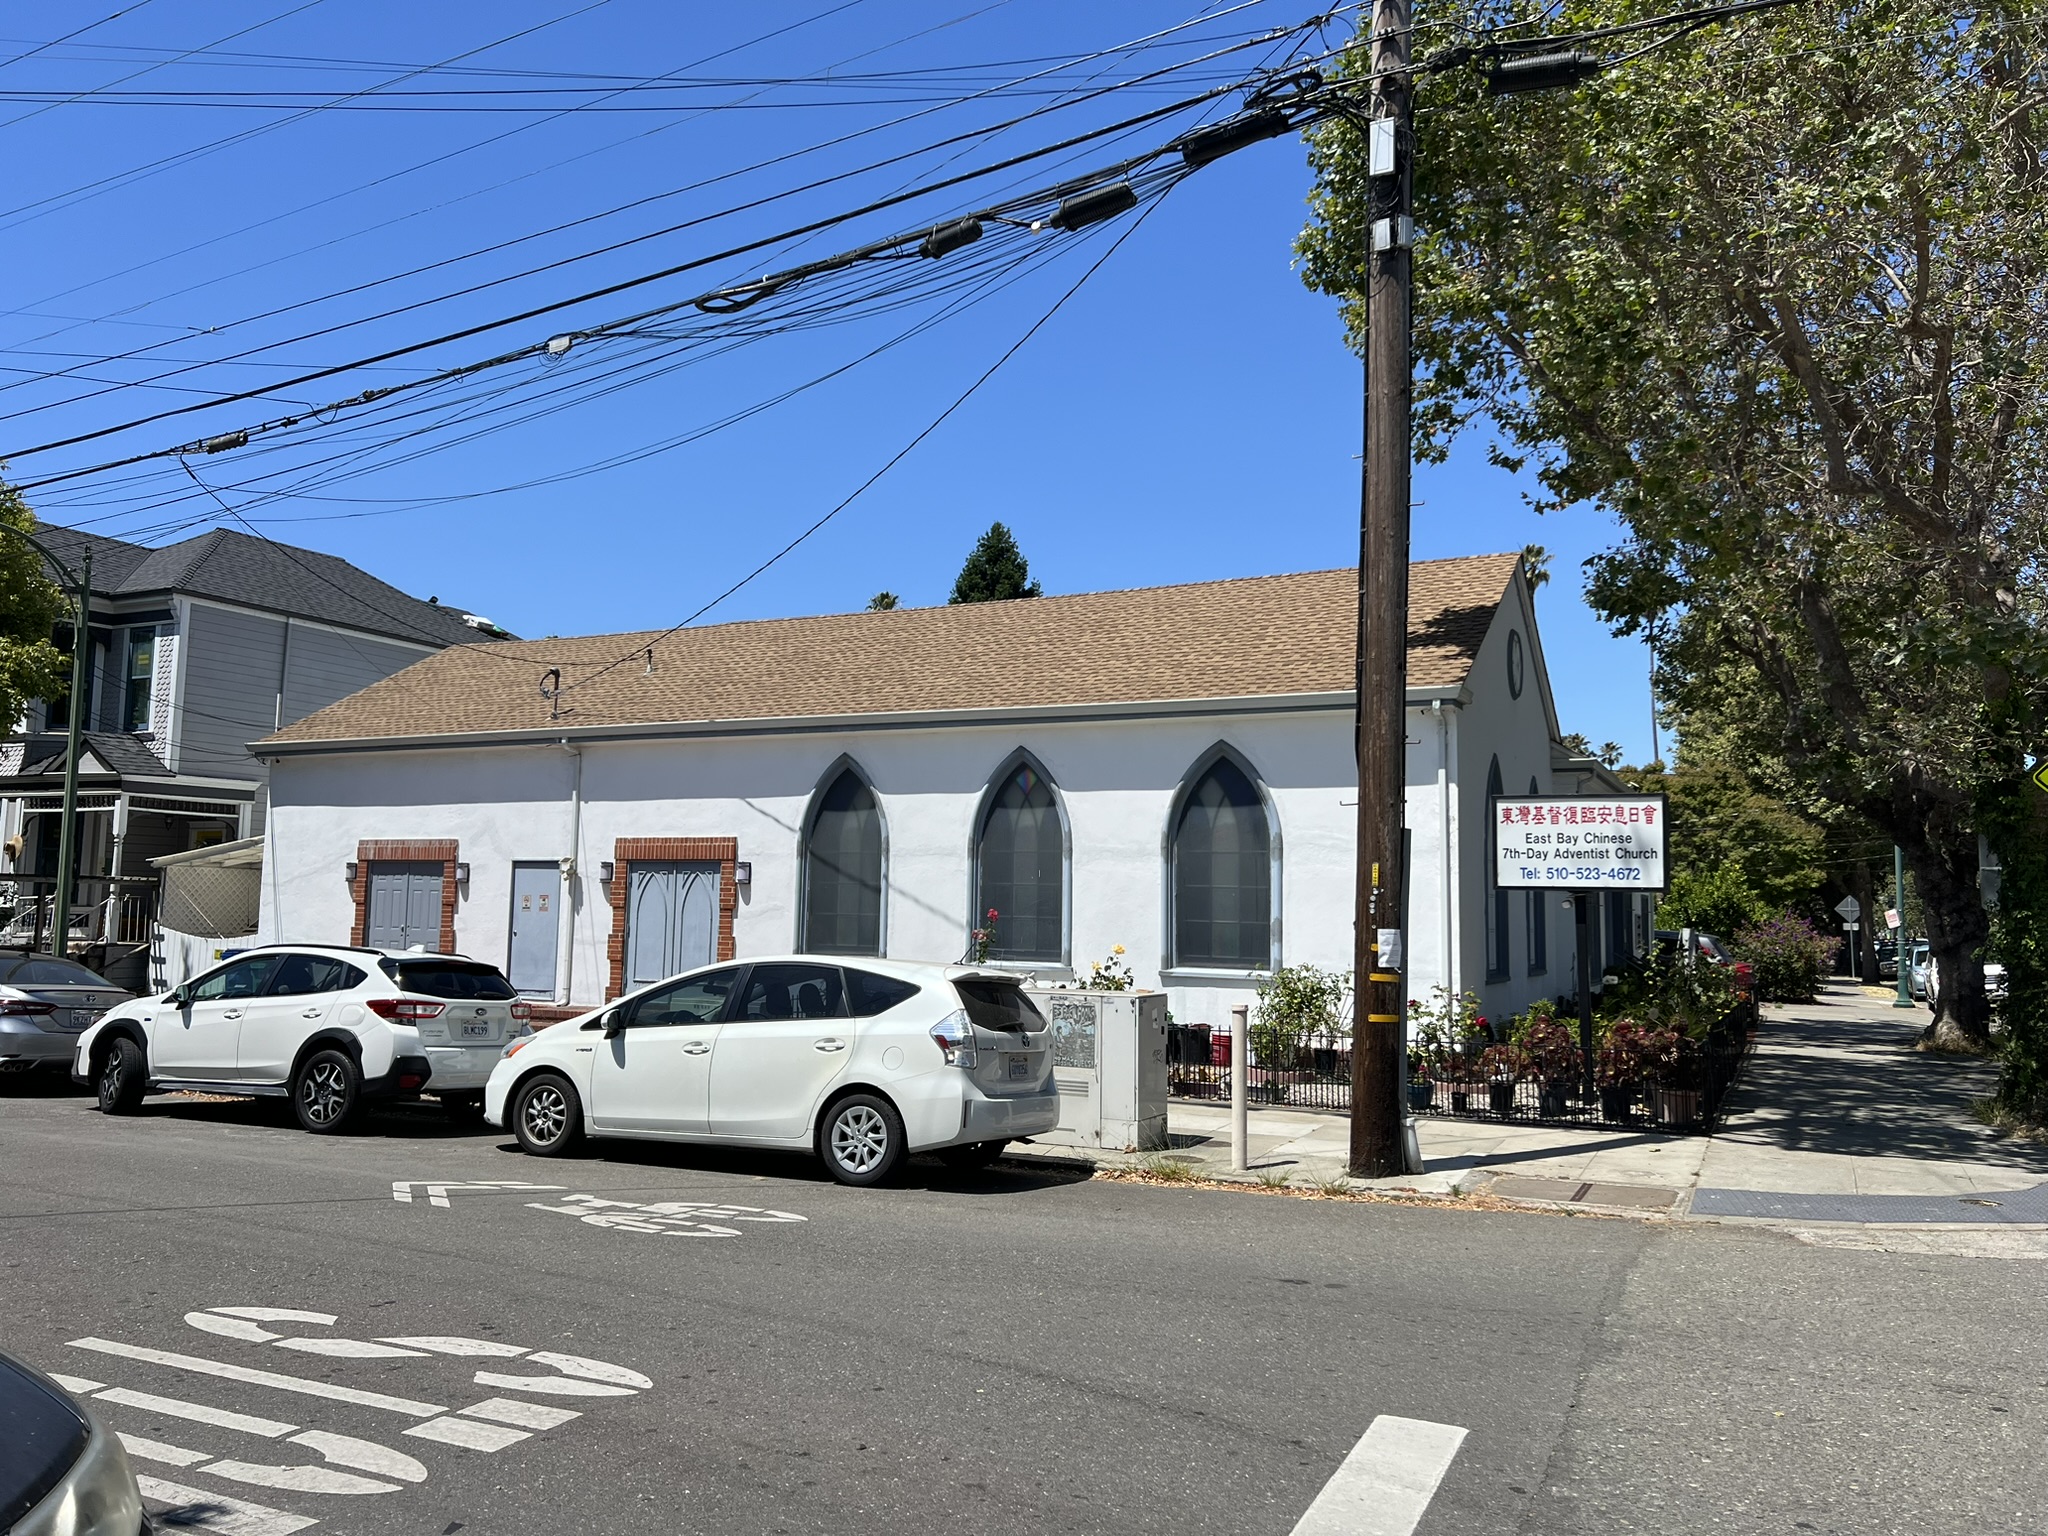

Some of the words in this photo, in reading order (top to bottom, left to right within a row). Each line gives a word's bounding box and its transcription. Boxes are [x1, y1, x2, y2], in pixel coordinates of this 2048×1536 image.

[1500, 804, 1657, 826] 東灣基督復臨安息日會
[1526, 832, 1551, 844] East
[1557, 832, 1579, 845] Bay
[1584, 832, 1633, 844] Chinese
[1503, 847, 1549, 861] 7th-Day
[1554, 847, 1610, 860] Adventist
[1615, 847, 1658, 860] Church
[1520, 867, 1541, 880] Tel:
[1546, 867, 1641, 881] 510-523-4672
